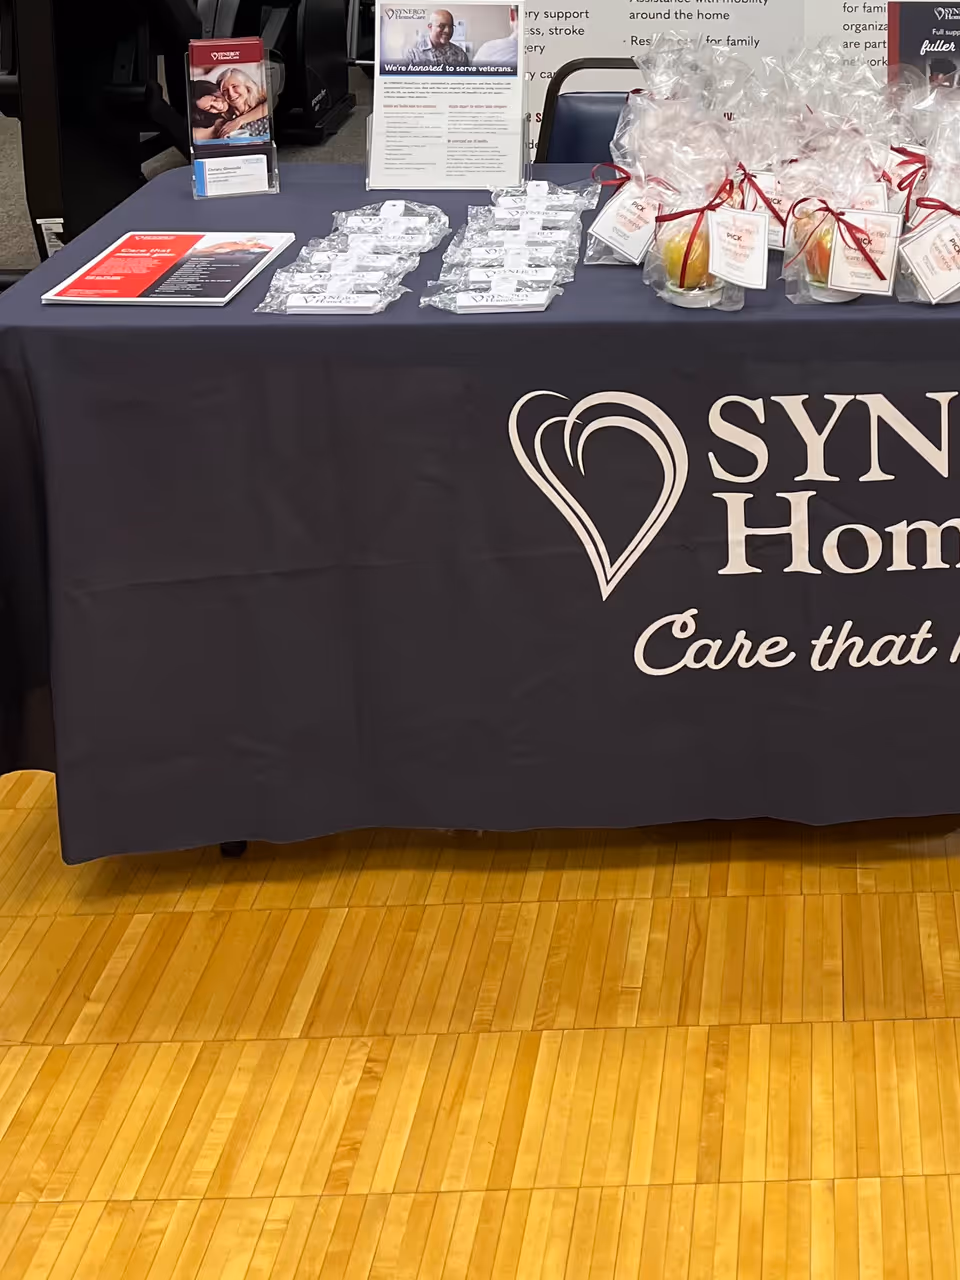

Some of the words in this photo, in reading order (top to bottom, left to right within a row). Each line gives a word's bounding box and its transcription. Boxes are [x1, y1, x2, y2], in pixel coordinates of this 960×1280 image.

[629, 8, 670, 20] around
[674, 8, 693, 20] the
[697, 8, 730, 20] home
[842, 3, 859, 13] for
[544, 9, 590, 21] support
[548, 25, 585, 35] stroke
[726, 35, 760, 48] family
[842, 41, 861, 49] are
[864, 39, 887, 51] part
[920, 39, 956, 56] fuller
[384, 63, 407, 72] We're
[407, 63, 443, 72] honored
[631, 200, 646, 213] PICK
[726, 232, 742, 242] PICK
[633, 607, 795, 676] Care
[811, 619, 938, 671] that
